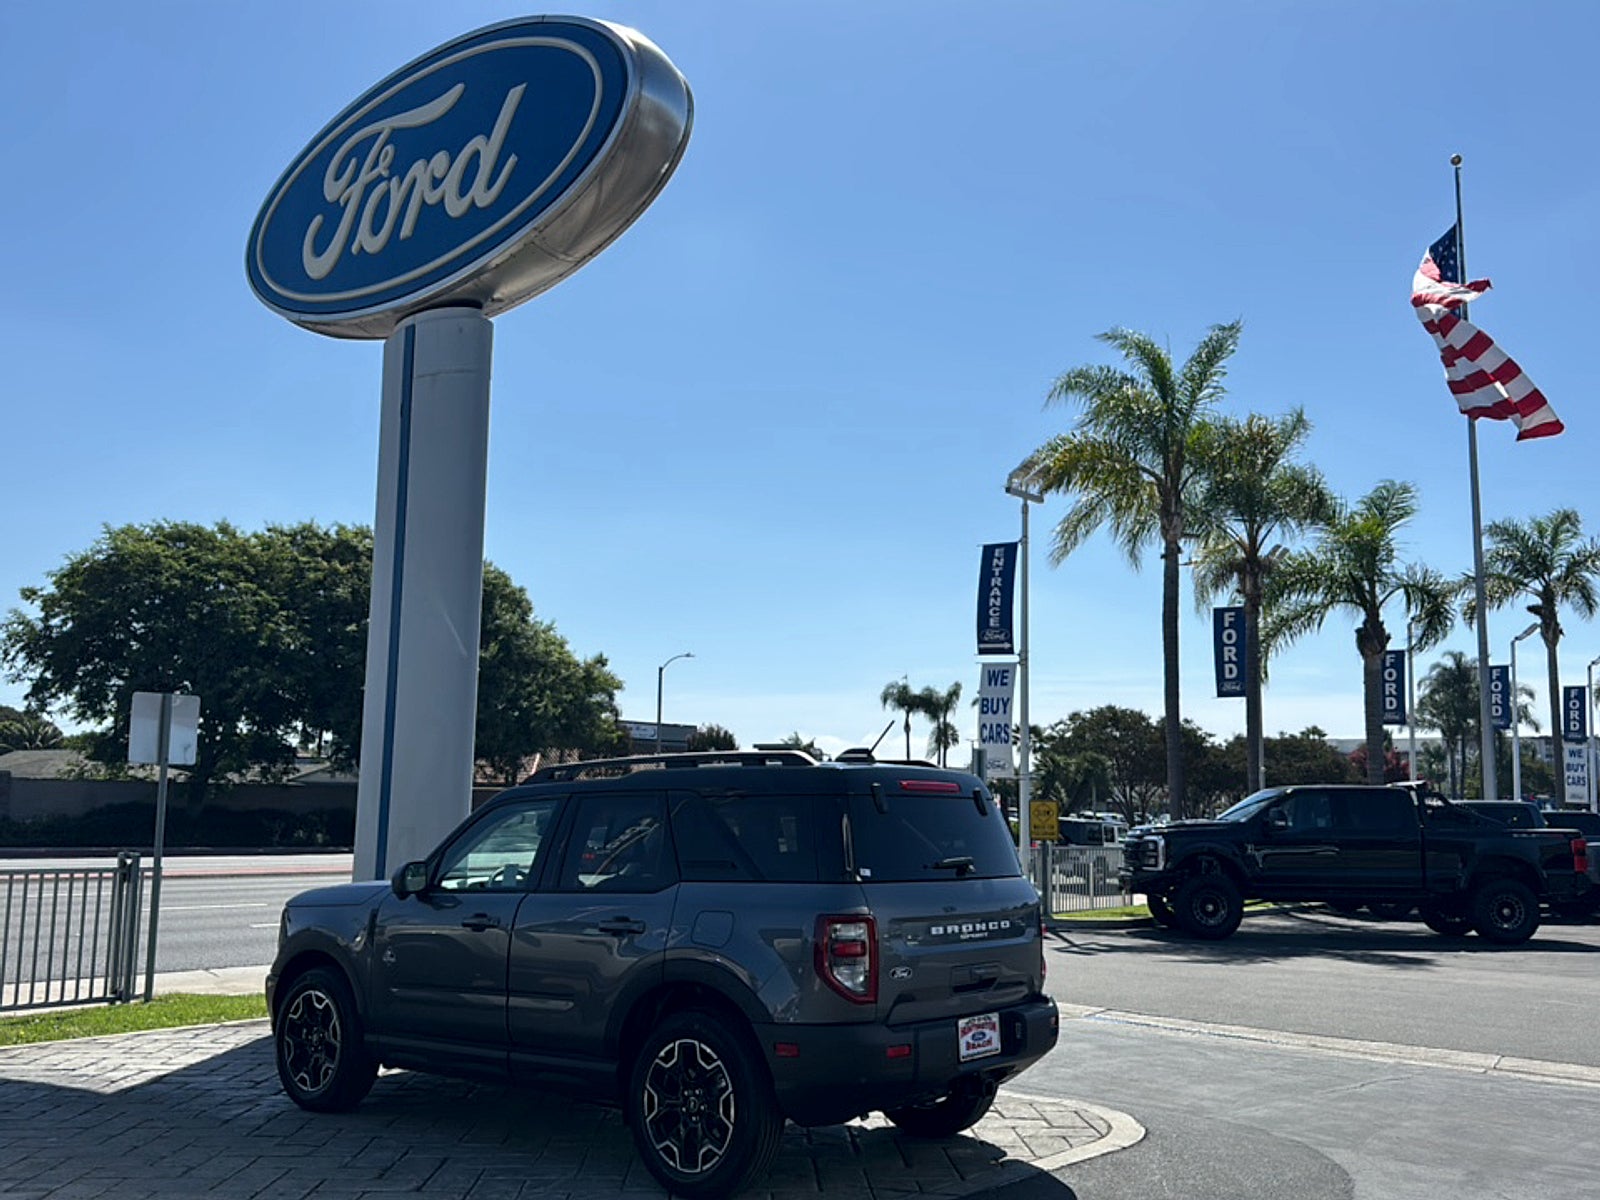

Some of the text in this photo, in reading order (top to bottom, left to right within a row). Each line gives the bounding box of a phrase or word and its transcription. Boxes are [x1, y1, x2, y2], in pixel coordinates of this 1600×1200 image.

[302, 82, 528, 280] Ford
[988, 547, 1005, 627] ENTRANCE
[1222, 611, 1238, 680] FORD
[987, 669, 1010, 687] WE
[1383, 654, 1398, 710] FORD
[1491, 668, 1503, 717] FORD
[981, 697, 1010, 715] BUY
[1568, 688, 1580, 732] FORD
[980, 723, 1010, 745] CARS
[1566, 763, 1586, 773] BUY
[1568, 749, 1583, 758] WE
[931, 919, 1010, 935] BRONCO
